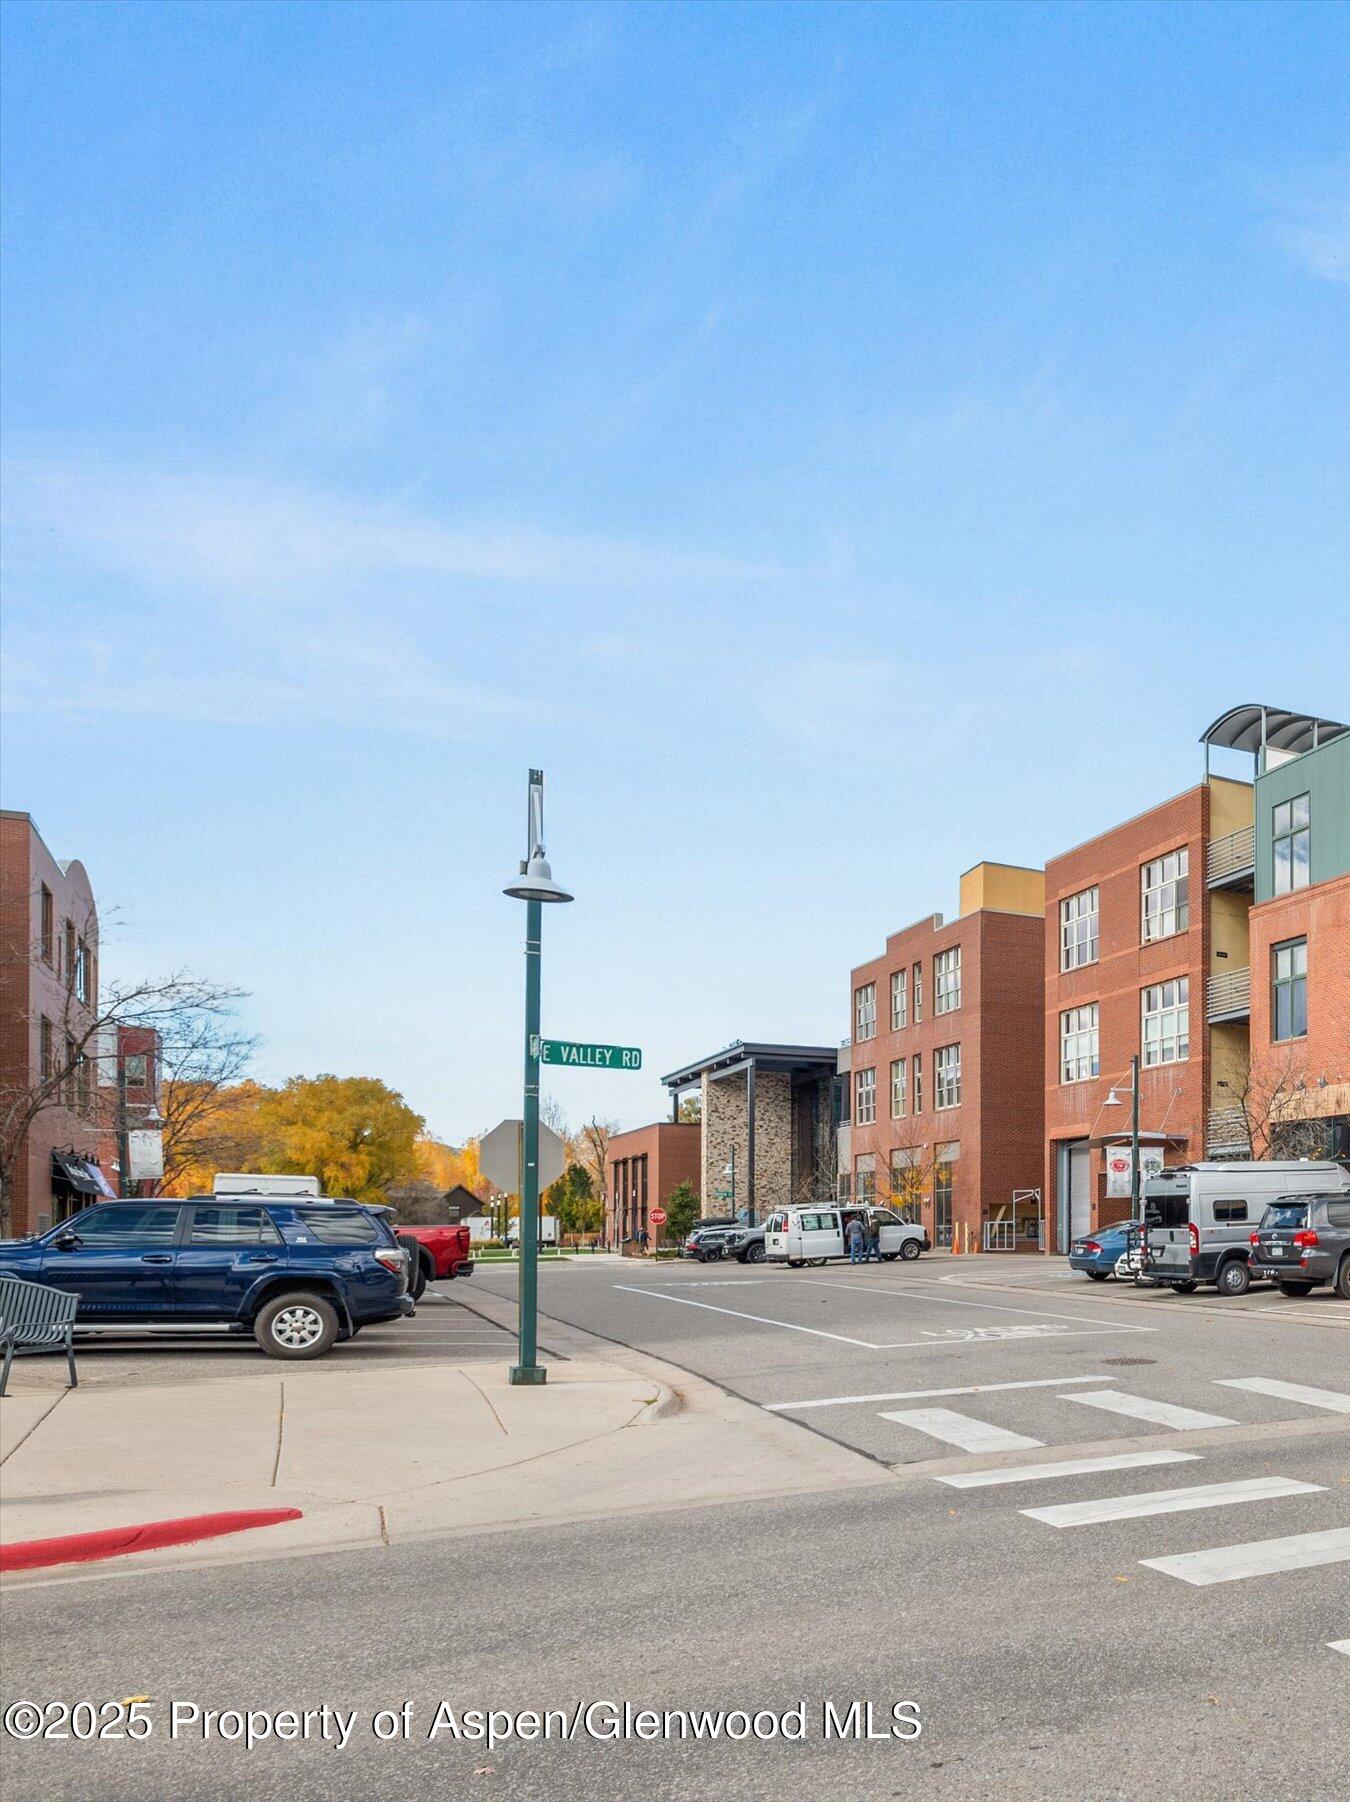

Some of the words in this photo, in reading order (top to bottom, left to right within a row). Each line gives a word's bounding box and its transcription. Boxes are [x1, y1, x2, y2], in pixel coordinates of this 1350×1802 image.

[543, 1045, 551, 1061] E
[560, 1046, 613, 1066] VALLEY
[622, 1050, 640, 1067] RD
[650, 1212, 666, 1220] STOP
